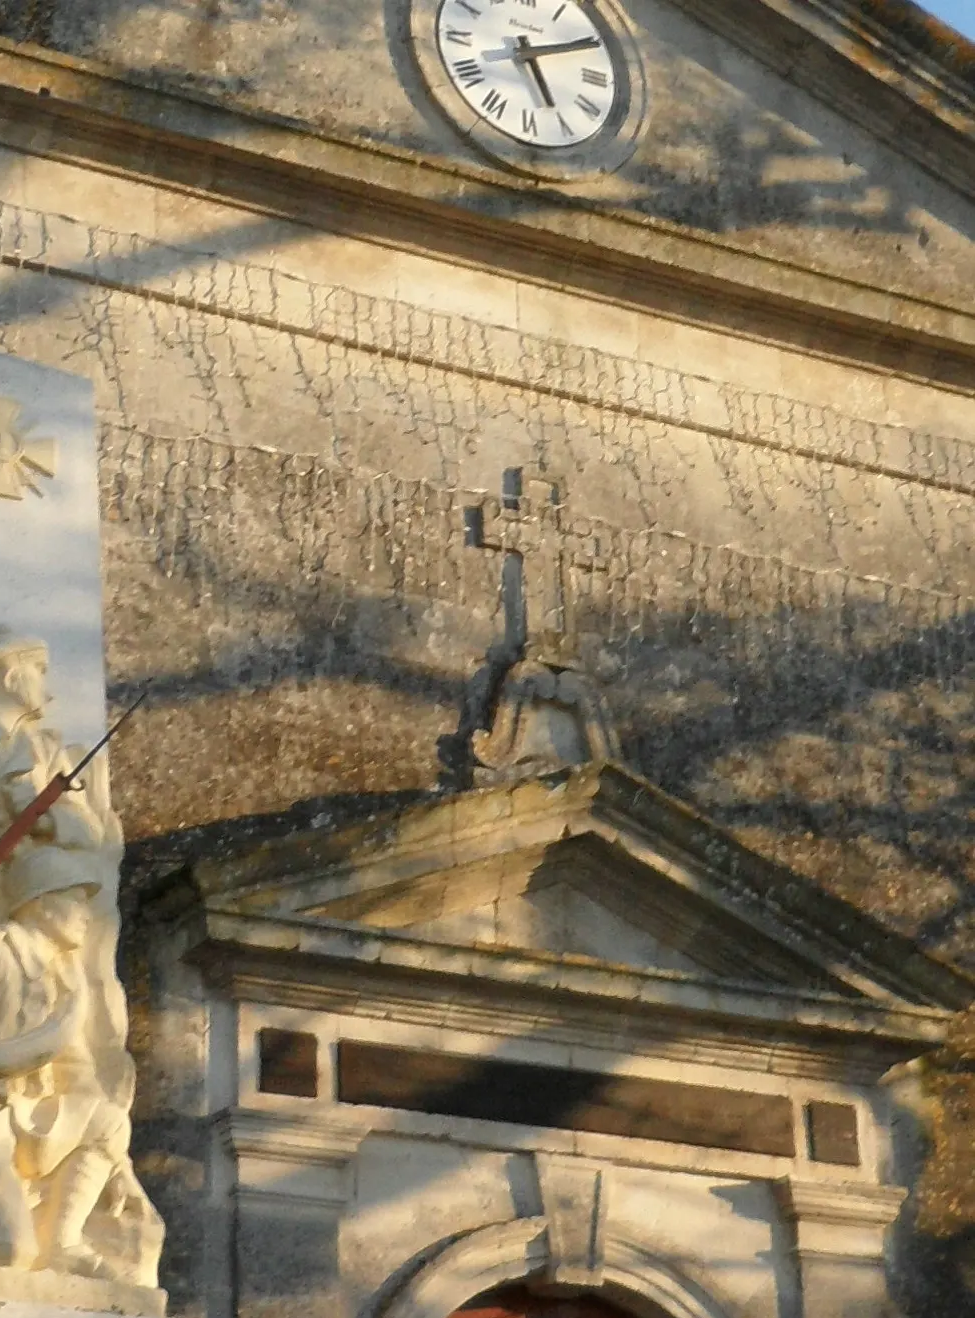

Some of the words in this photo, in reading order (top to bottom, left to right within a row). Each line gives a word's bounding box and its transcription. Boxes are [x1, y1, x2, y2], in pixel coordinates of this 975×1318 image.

[552, 3, 567, 22] I
[481, 88, 509, 121] VII
[522, 108, 539, 138] VI
